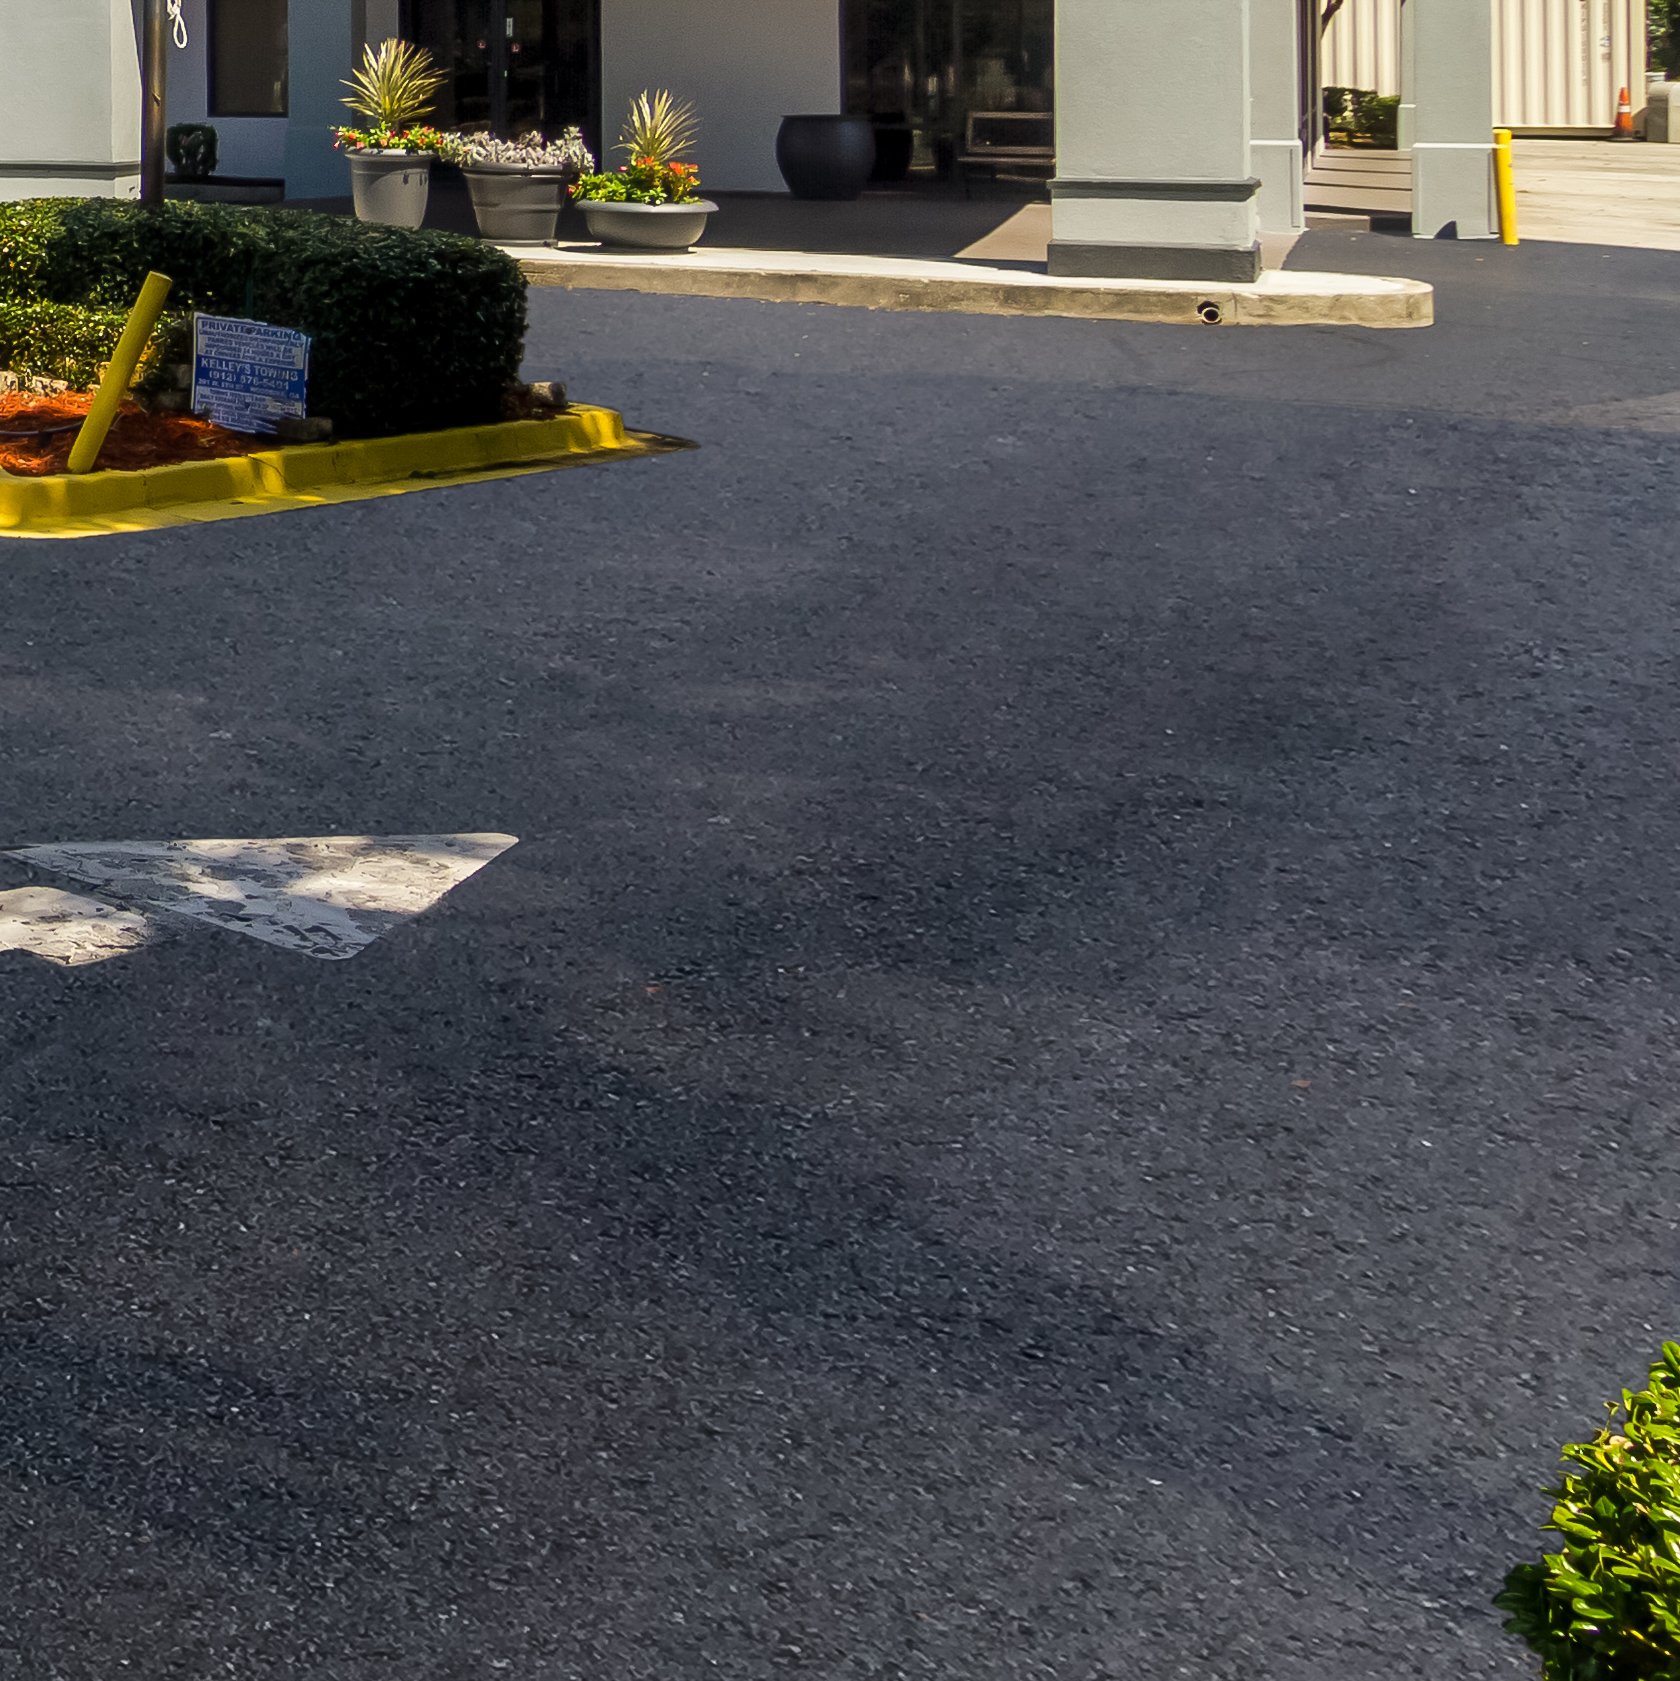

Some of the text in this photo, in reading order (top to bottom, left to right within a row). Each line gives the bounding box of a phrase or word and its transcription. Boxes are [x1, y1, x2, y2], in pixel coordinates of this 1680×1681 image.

[201, 320, 302, 341] PRIVATE PARKING
[201, 358, 299, 381] KELLEY'S TOWING
